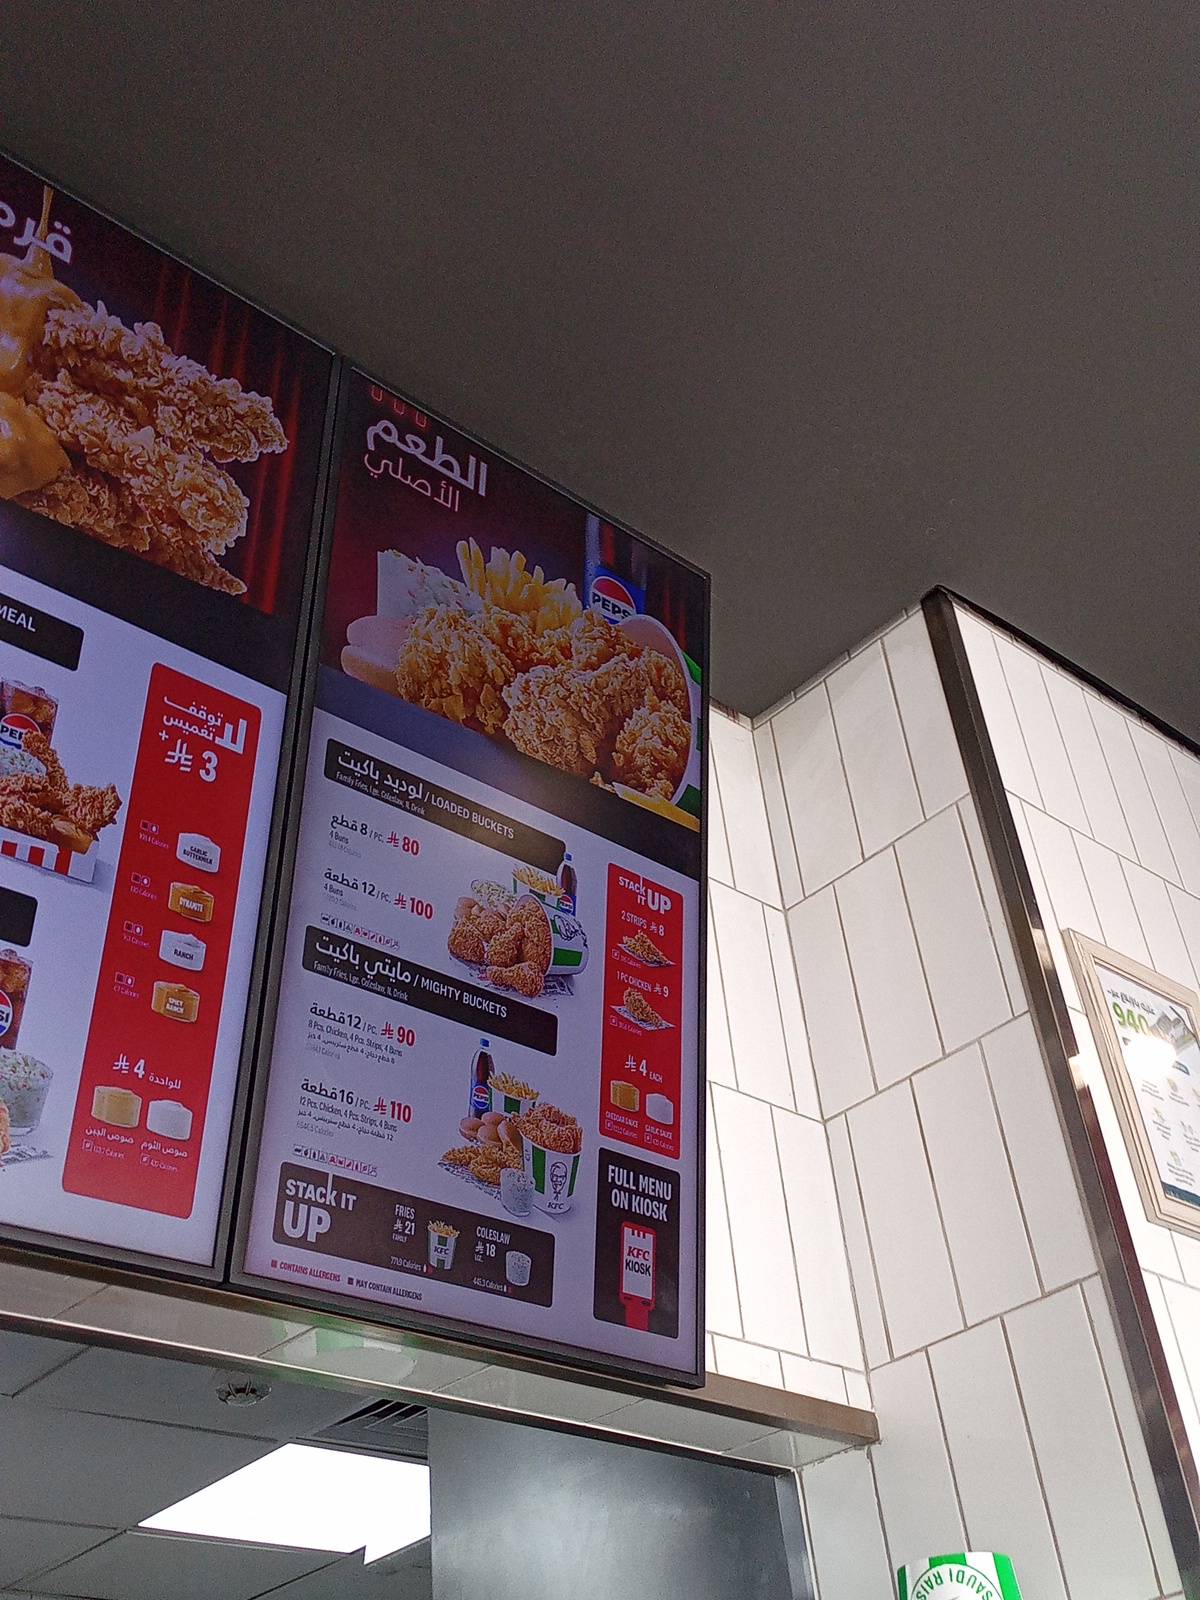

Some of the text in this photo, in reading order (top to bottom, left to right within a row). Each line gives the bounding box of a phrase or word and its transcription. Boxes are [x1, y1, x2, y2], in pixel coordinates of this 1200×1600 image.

[366, 420, 487, 497] الطعم
[364, 454, 460, 512] الأصلي
[0, 605, 36, 632] MEAL
[164, 696, 224, 726] توقف
[163, 715, 215, 741] تغميس
[199, 751, 218, 782] 3
[338, 751, 379, 785] باكيت
[383, 774, 423, 799] لوديد
[431, 794, 470, 819] LOADED
[330, 814, 358, 832] قطع
[360, 823, 368, 835] 8
[472, 812, 514, 839] BUCKETS
[402, 836, 419, 856] 80
[324, 868, 358, 890] قطعة
[362, 881, 375, 897] 12
[618, 876, 671, 915] STACK UP
[637, 894, 646, 906] IT
[410, 897, 433, 919] 100
[621, 910, 664, 936] 2 STRIPS 8
[174, 948, 194, 960] RANCH
[316, 936, 359, 970] باكيت
[364, 958, 411, 983] مايتي
[421, 977, 461, 1001] MIGHTY
[663, 986, 669, 998] 9
[310, 1002, 345, 1024] قطعة
[462, 992, 507, 1018] BUCKETS
[347, 1014, 361, 1030] 12
[397, 1026, 415, 1047] 90
[134, 1059, 181, 1089] 4 للواحدة
[639, 1059, 647, 1076] 4
[301, 1078, 337, 1100] قطعة
[339, 1089, 354, 1105] 16
[390, 1101, 411, 1123] 110
[608, 1164, 672, 1201] FULL MENU
[285, 1179, 357, 1211] STACK IT
[611, 1188, 668, 1222] ON KIOSK
[395, 1204, 415, 1220] FRIES
[547, 1202, 565, 1213] KFC
[283, 1200, 331, 1243] UP
[404, 1221, 415, 1235] 21
[476, 1226, 511, 1245] COLESLAW
[434, 1244, 450, 1255] KFC
[486, 1243, 496, 1257] 18
[627, 1246, 650, 1261] KFC
[279, 1261, 341, 1282] CONTAINS ALLERGENS
[625, 1258, 651, 1277] KIOSK
[368, 1282, 392, 1294] CONTAIN
[392, 1287, 422, 1301] ALLERGENS
